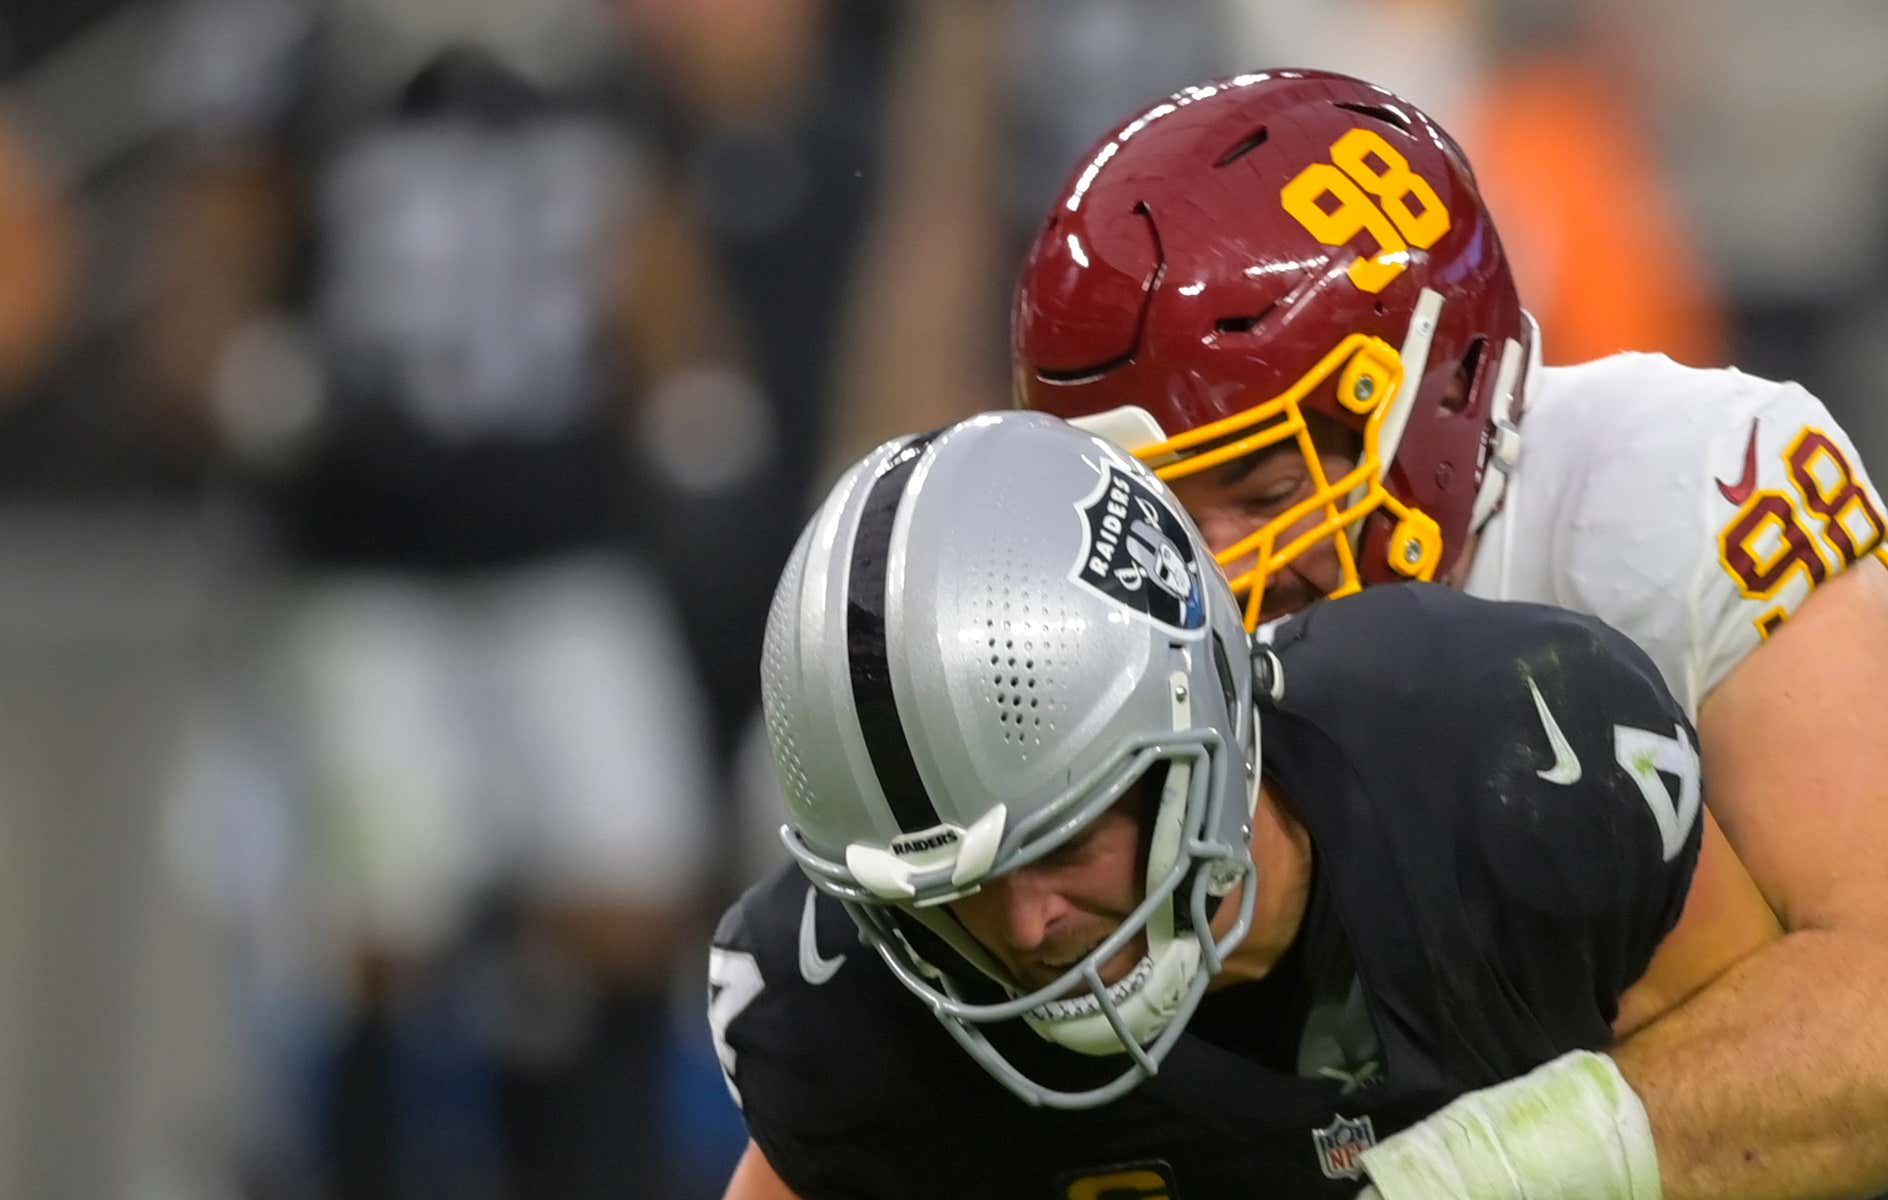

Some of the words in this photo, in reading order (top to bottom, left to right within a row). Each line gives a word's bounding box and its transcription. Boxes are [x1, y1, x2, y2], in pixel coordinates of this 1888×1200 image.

[1281, 128, 1451, 293] 98
[1088, 475, 1131, 579] RAIDERS
[892, 829, 958, 855] RAIDERS
[1613, 723, 1701, 863] 4
